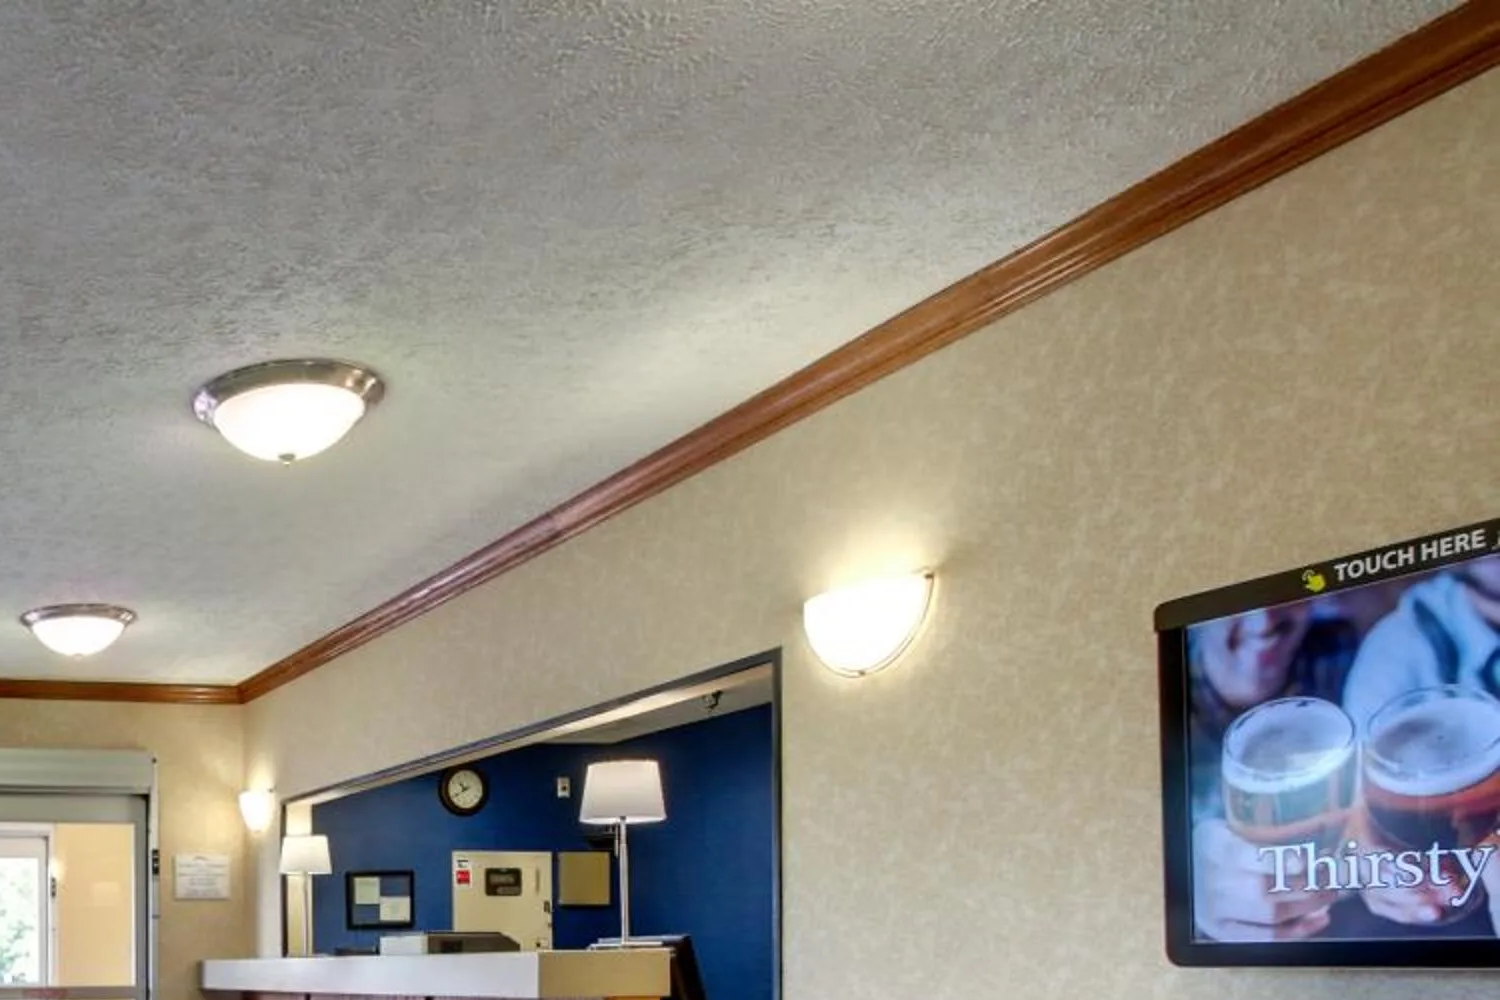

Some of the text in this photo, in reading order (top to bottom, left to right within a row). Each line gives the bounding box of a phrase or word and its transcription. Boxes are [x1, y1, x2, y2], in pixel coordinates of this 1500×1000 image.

[1334, 529, 1487, 581] TOUCH HERE
[1258, 841, 1495, 907] Thirsty
